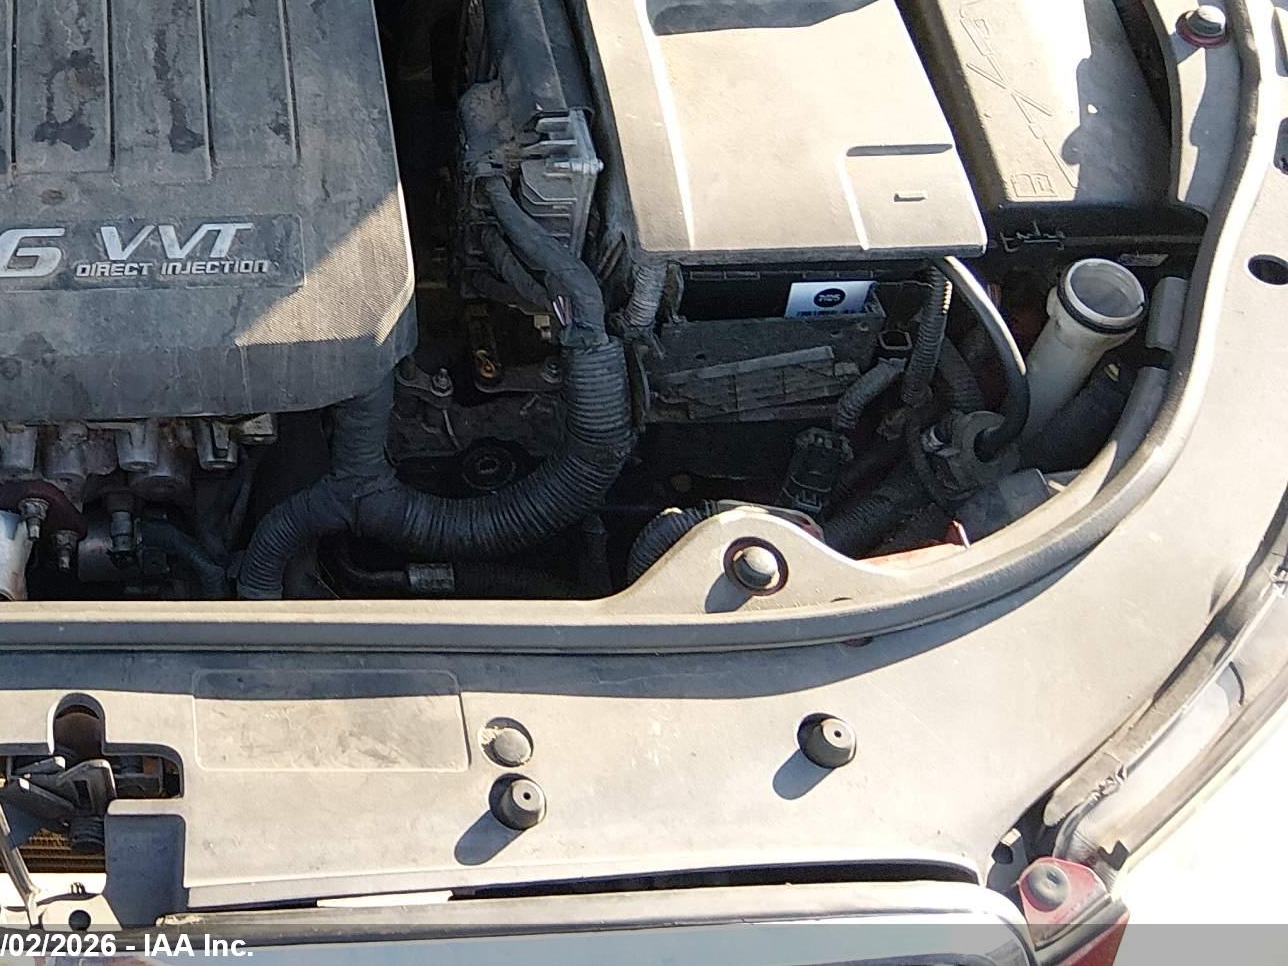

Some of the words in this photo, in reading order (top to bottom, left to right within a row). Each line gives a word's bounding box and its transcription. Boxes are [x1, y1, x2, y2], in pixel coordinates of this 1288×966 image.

[99, 223, 254, 262] VVT
[73, 262, 153, 279] DIRECT
[160, 258, 270, 277] INJECTION
